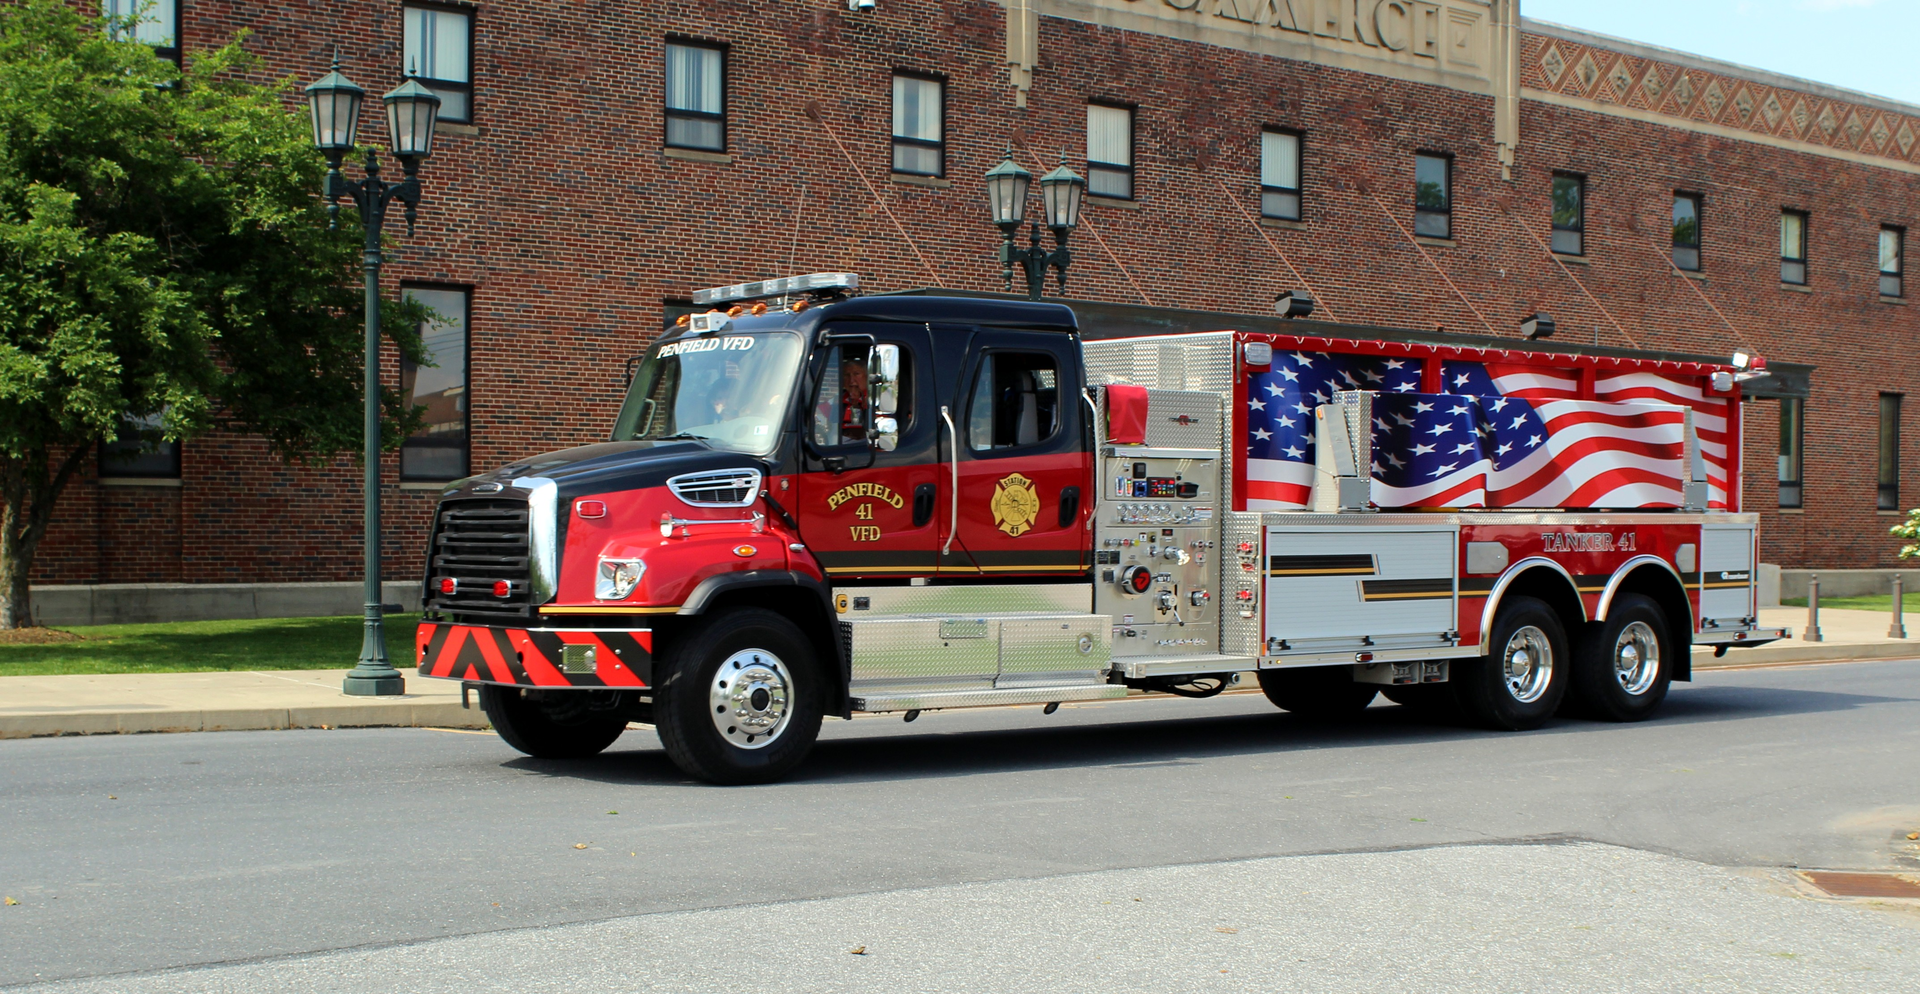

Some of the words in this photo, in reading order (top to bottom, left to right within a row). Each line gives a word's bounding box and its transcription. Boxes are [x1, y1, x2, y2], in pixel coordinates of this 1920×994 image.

[656, 338, 720, 359] PENFIELD
[722, 336, 755, 351] VFD
[1003, 477, 1028, 487] STATION
[827, 482, 904, 511] PENFIELD
[855, 503, 873, 520] 41
[849, 525, 881, 542] VFD
[1009, 526, 1019, 535] 41
[1541, 532, 1615, 552] TANKER
[1617, 532, 1637, 551] 41
